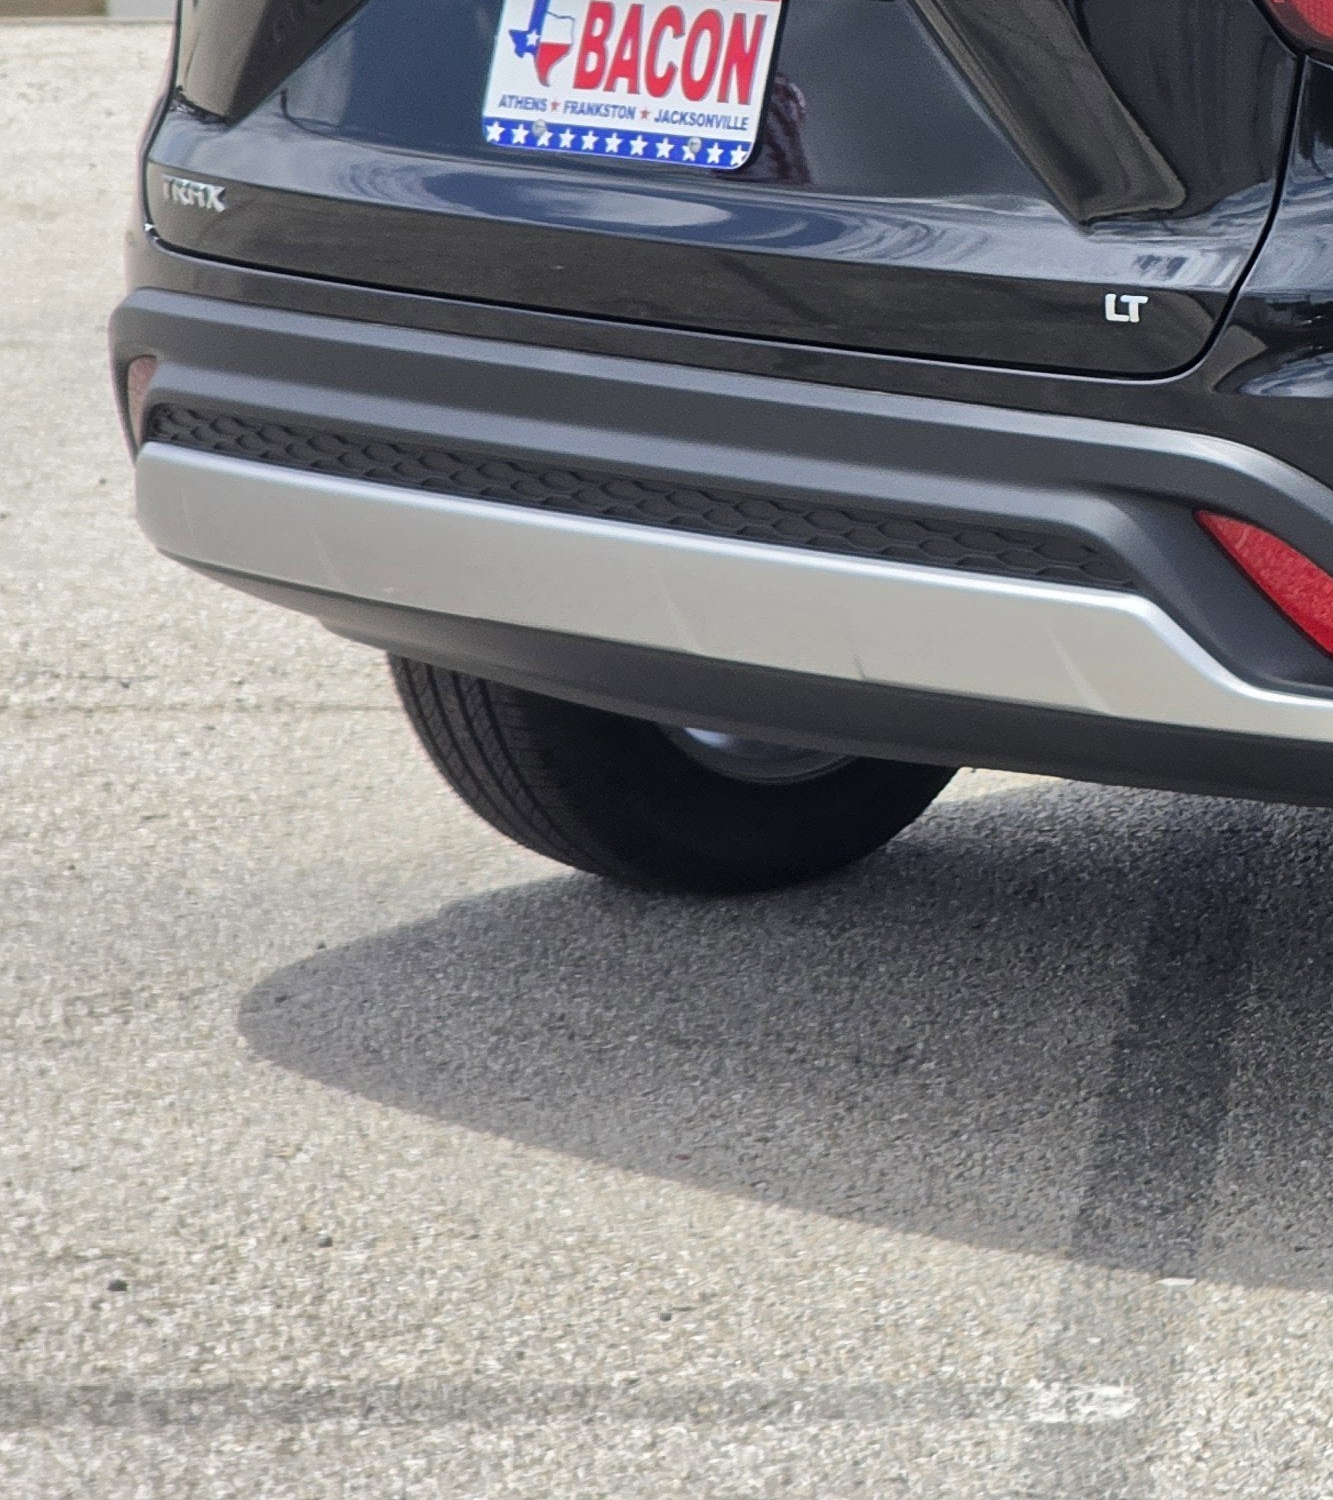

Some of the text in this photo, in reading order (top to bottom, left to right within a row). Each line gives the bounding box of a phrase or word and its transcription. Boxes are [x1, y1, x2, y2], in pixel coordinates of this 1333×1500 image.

[573, 0, 768, 105] BACON
[497, 93, 750, 132] ATHENS FRANKSTON JACKSONVILLE
[162, 173, 228, 213] TRAX
[1104, 293, 1149, 323] LT
